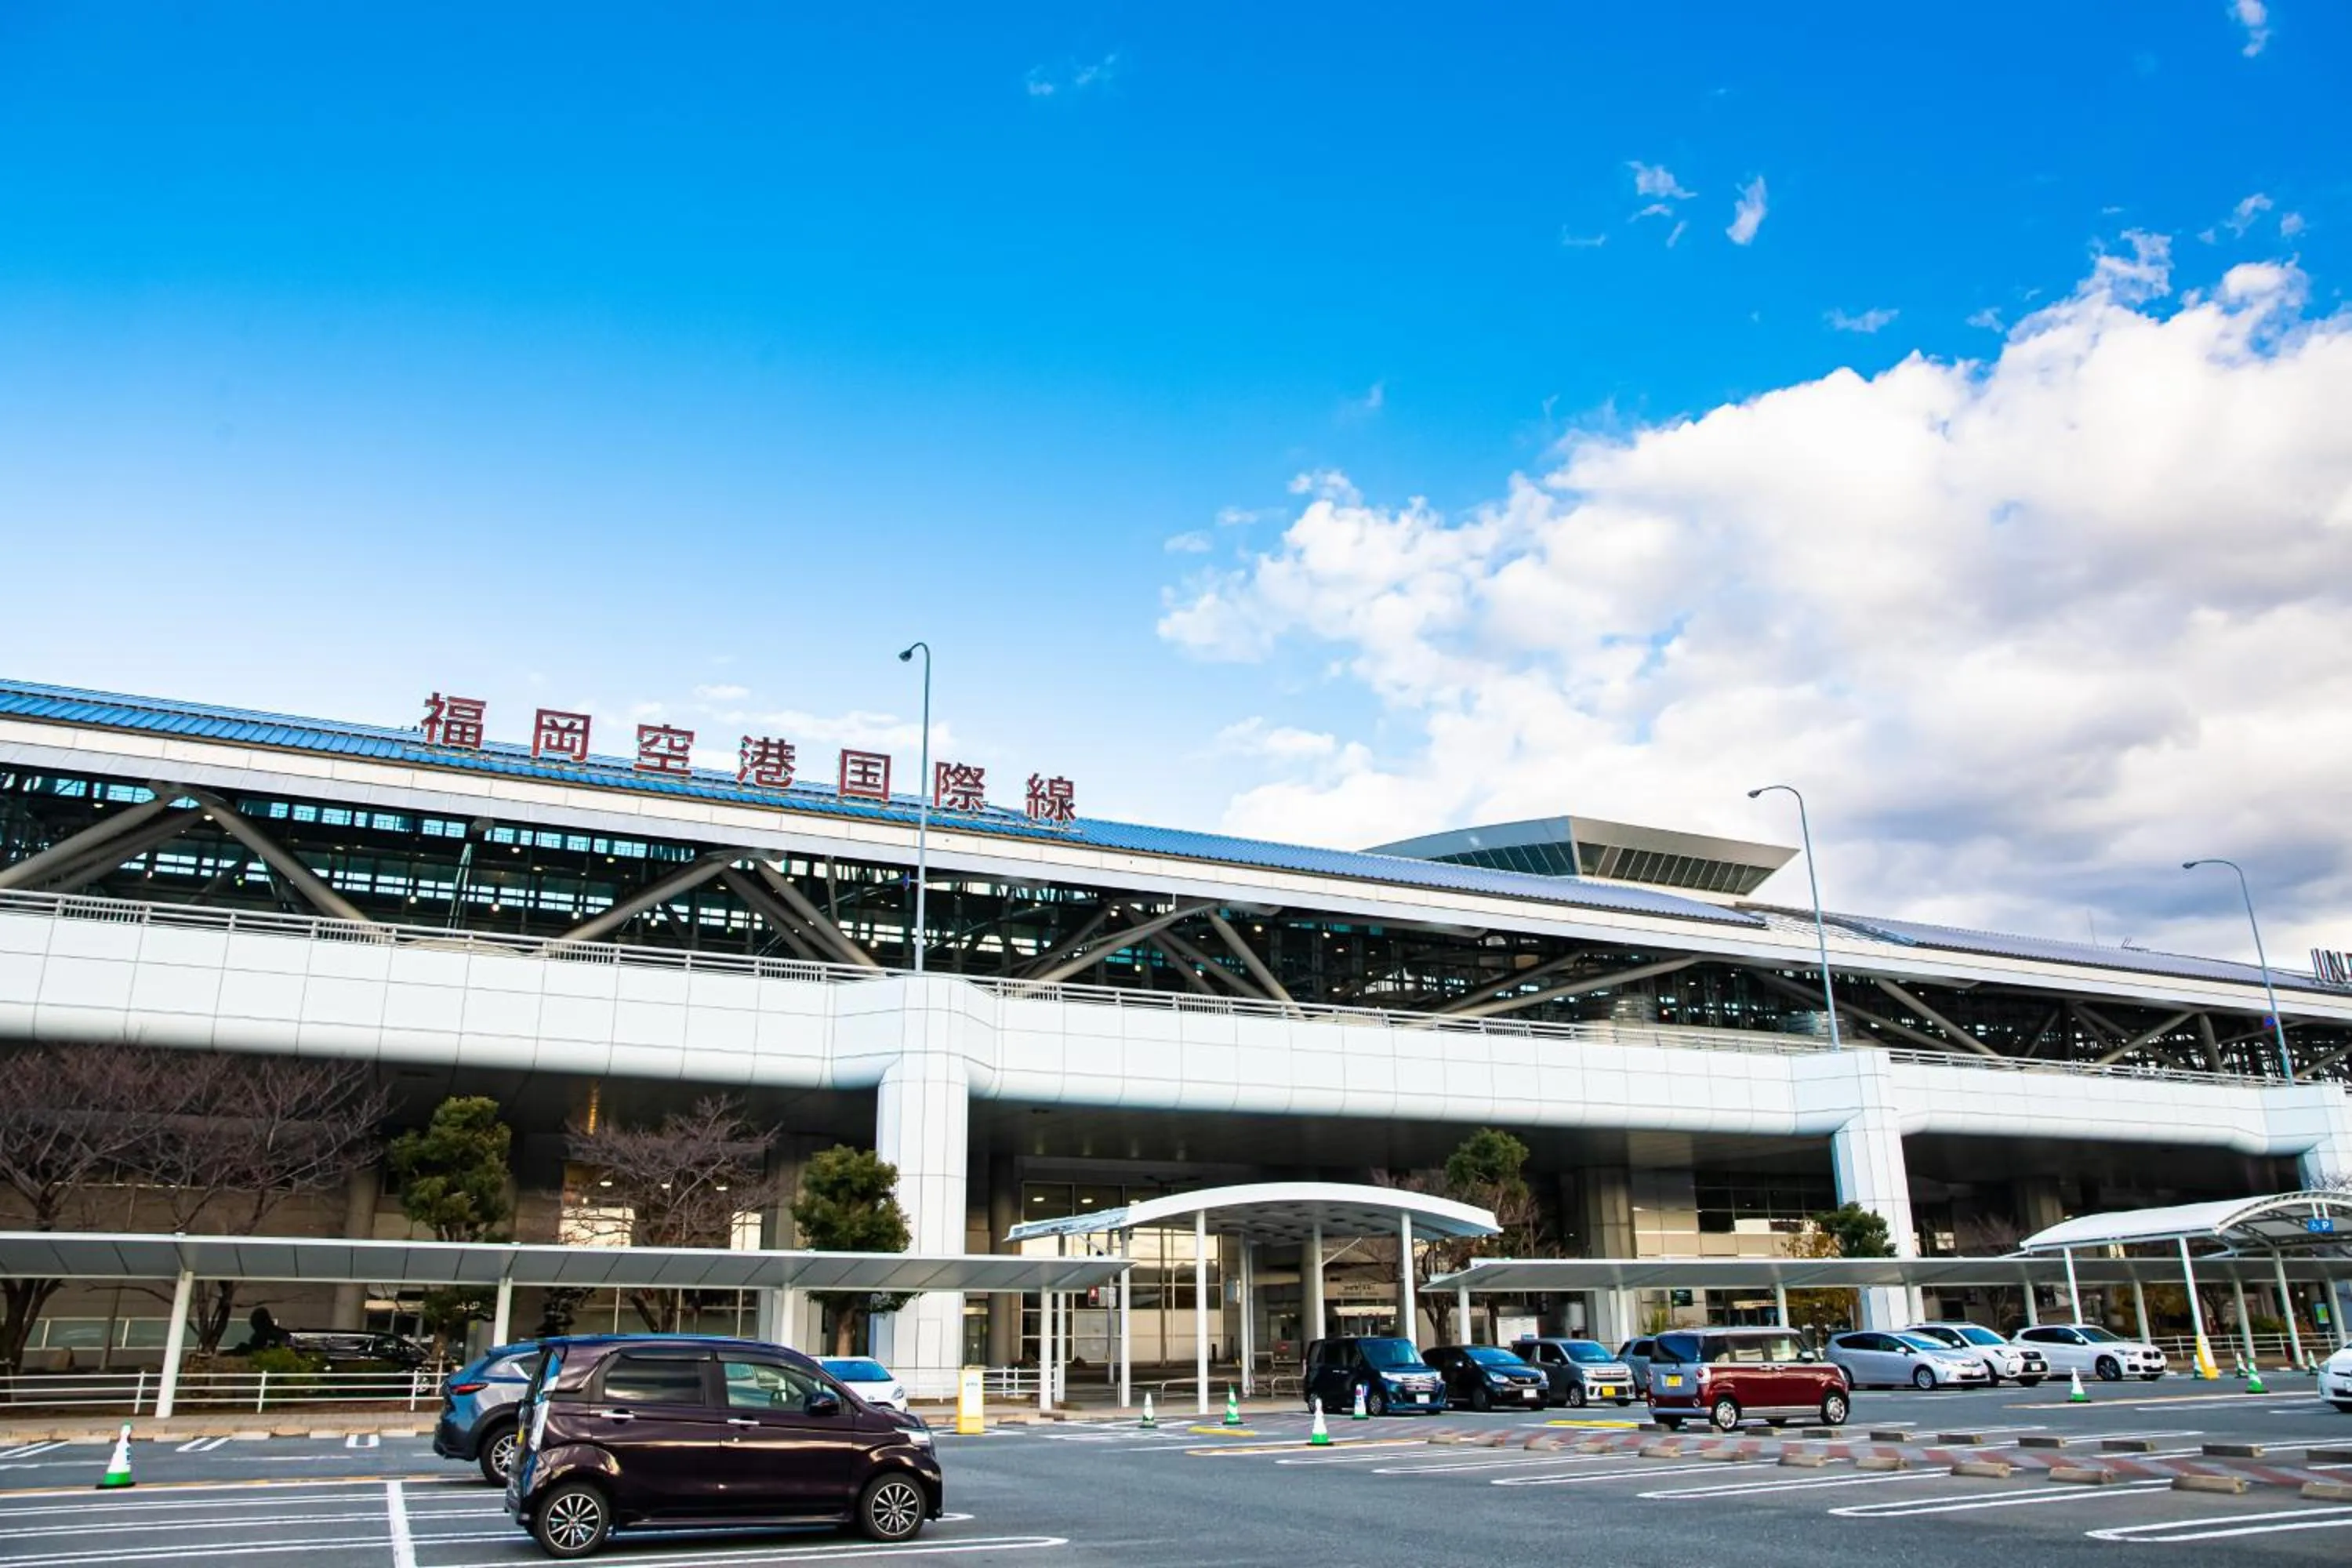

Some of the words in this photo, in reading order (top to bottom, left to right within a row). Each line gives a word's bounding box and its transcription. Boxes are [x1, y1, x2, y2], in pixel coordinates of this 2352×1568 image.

[421, 692, 1076, 821] 福岡空港国際線
[2321, 1221, 2329, 1230] P
